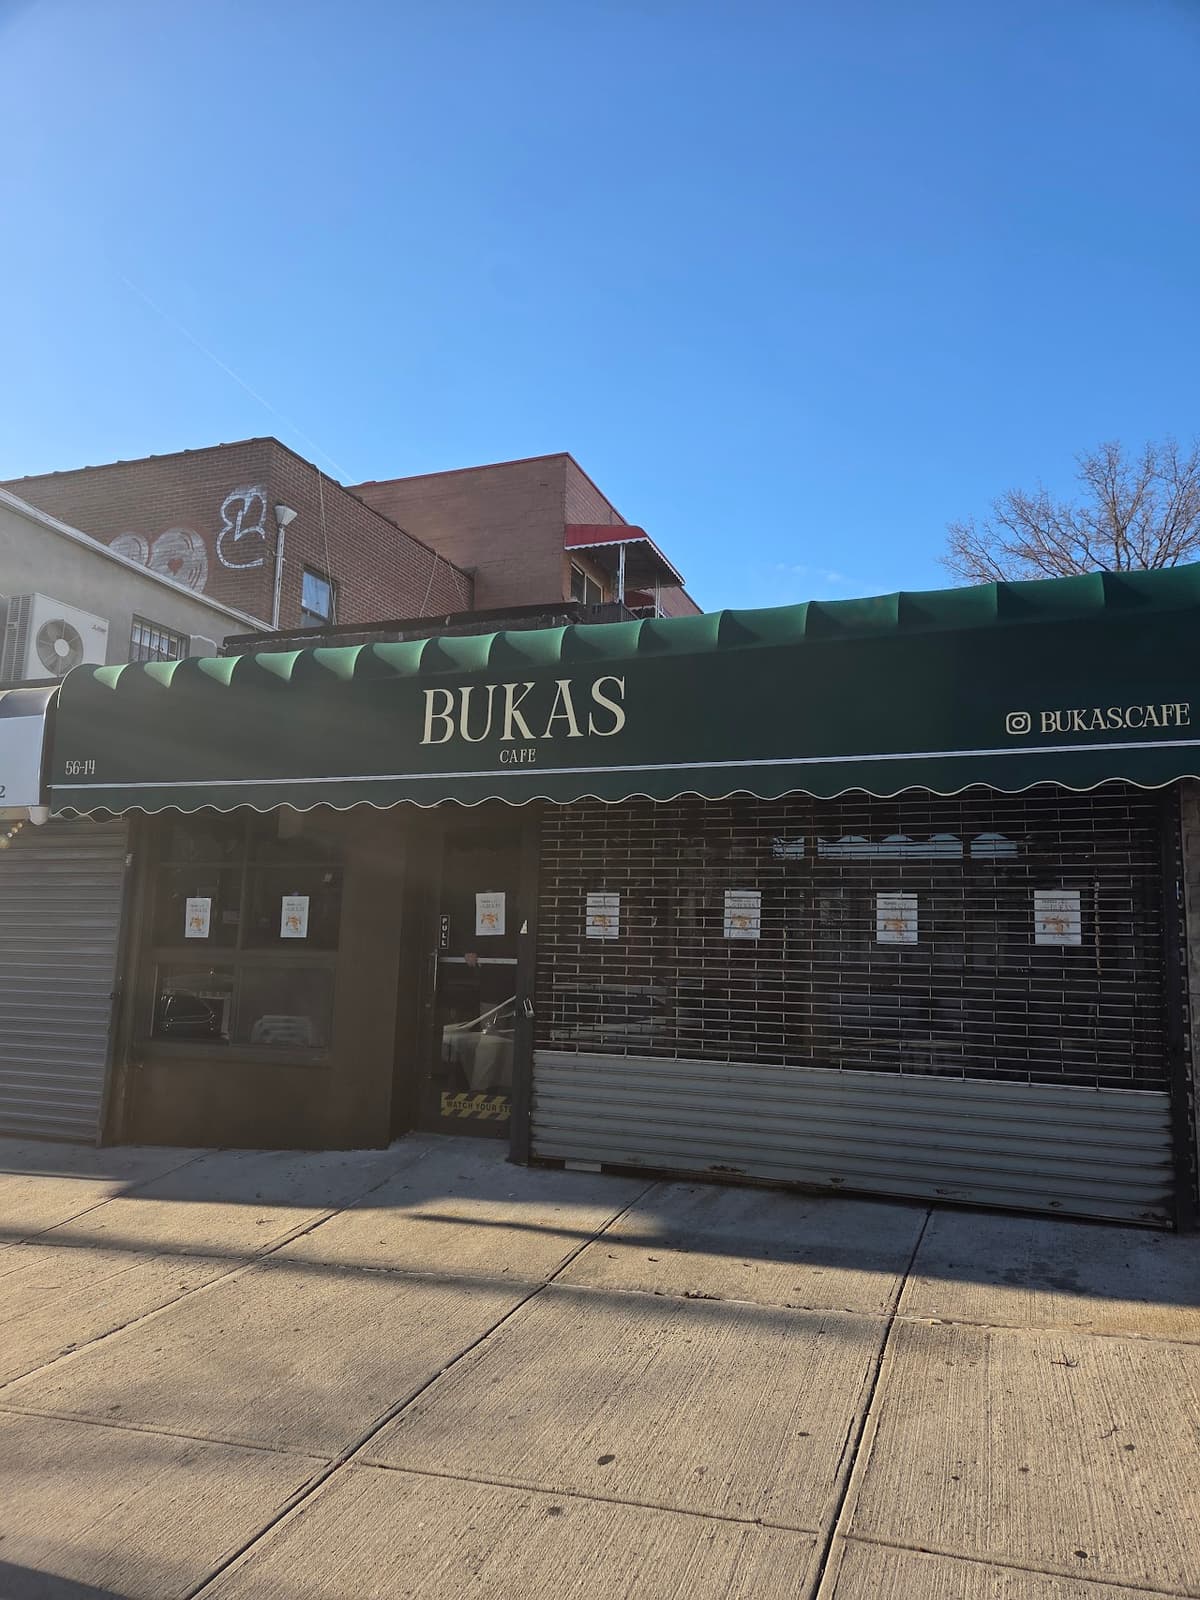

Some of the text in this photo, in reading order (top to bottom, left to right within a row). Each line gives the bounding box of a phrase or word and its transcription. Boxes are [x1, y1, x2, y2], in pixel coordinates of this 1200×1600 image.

[419, 675, 626, 745] BUKAS
[1040, 702, 1191, 733] BUKAS.CAFE
[499, 748, 536, 764] CAFE
[65, 760, 96, 775] 56-14
[441, 917, 449, 946] PULL
[446, 1101, 473, 1110] WATCH
[476, 1103, 497, 1112] YOUR
